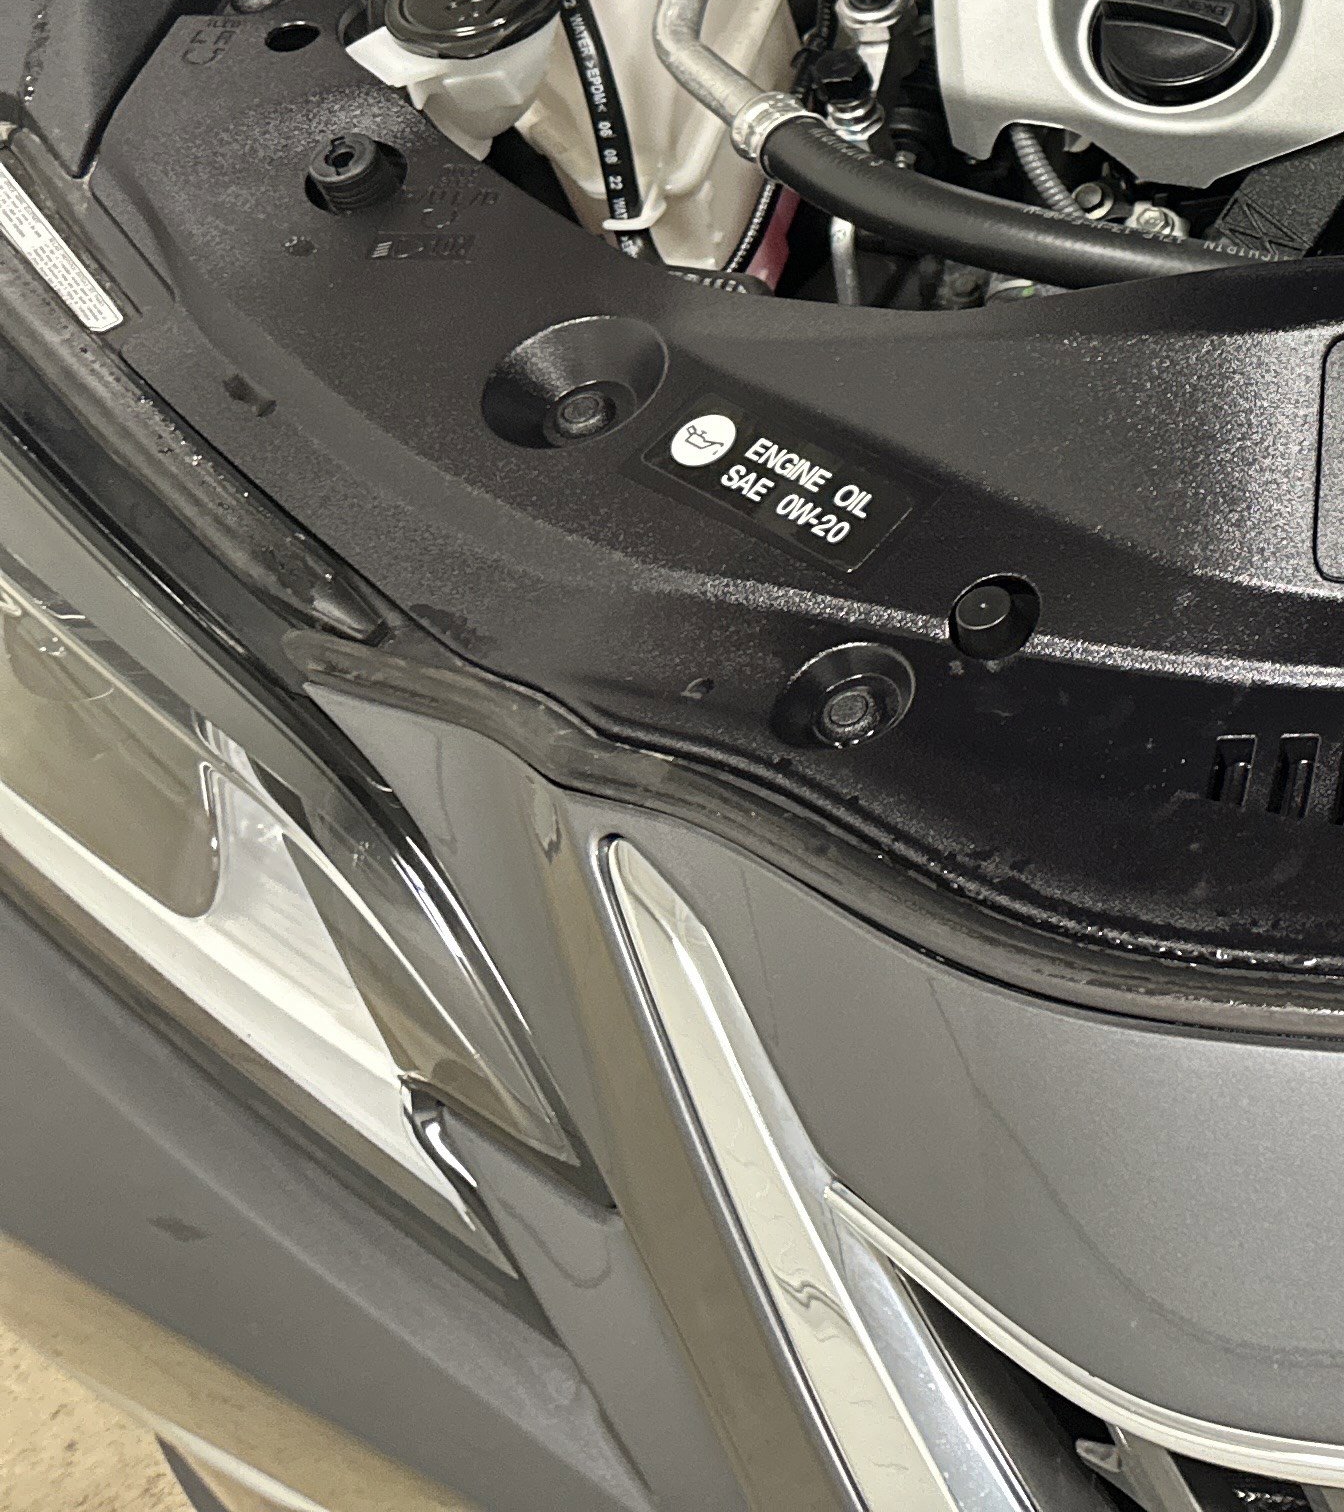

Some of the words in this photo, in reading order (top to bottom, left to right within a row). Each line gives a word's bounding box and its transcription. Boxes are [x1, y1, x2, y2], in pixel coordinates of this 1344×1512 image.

[720, 464, 775, 502] SAE
[776, 493, 851, 544] 0W-20
[744, 437, 833, 493] ENGINE
[833, 484, 873, 519] OIL
